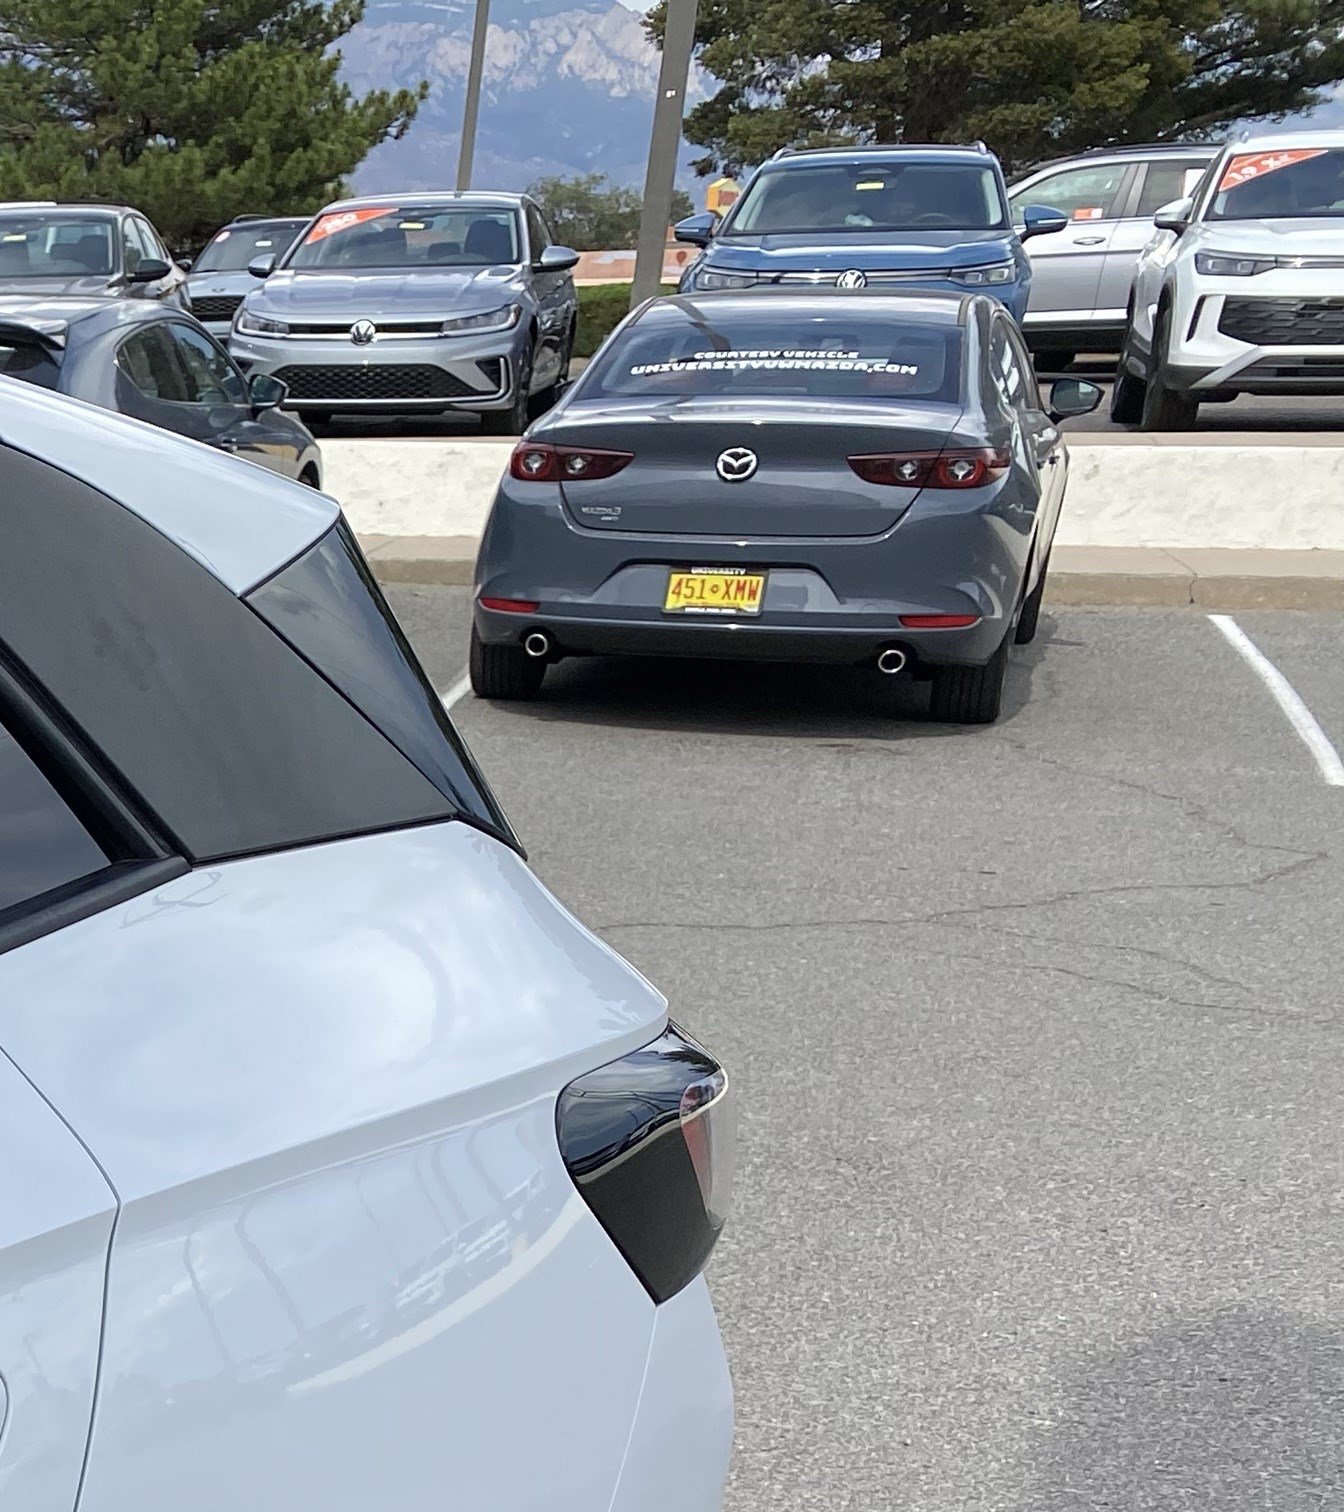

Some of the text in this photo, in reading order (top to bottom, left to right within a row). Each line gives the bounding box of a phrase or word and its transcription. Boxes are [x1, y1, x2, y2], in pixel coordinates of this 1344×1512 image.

[783, 350, 861, 360] VEHICLE
[671, 577, 761, 601] 451 XMW
